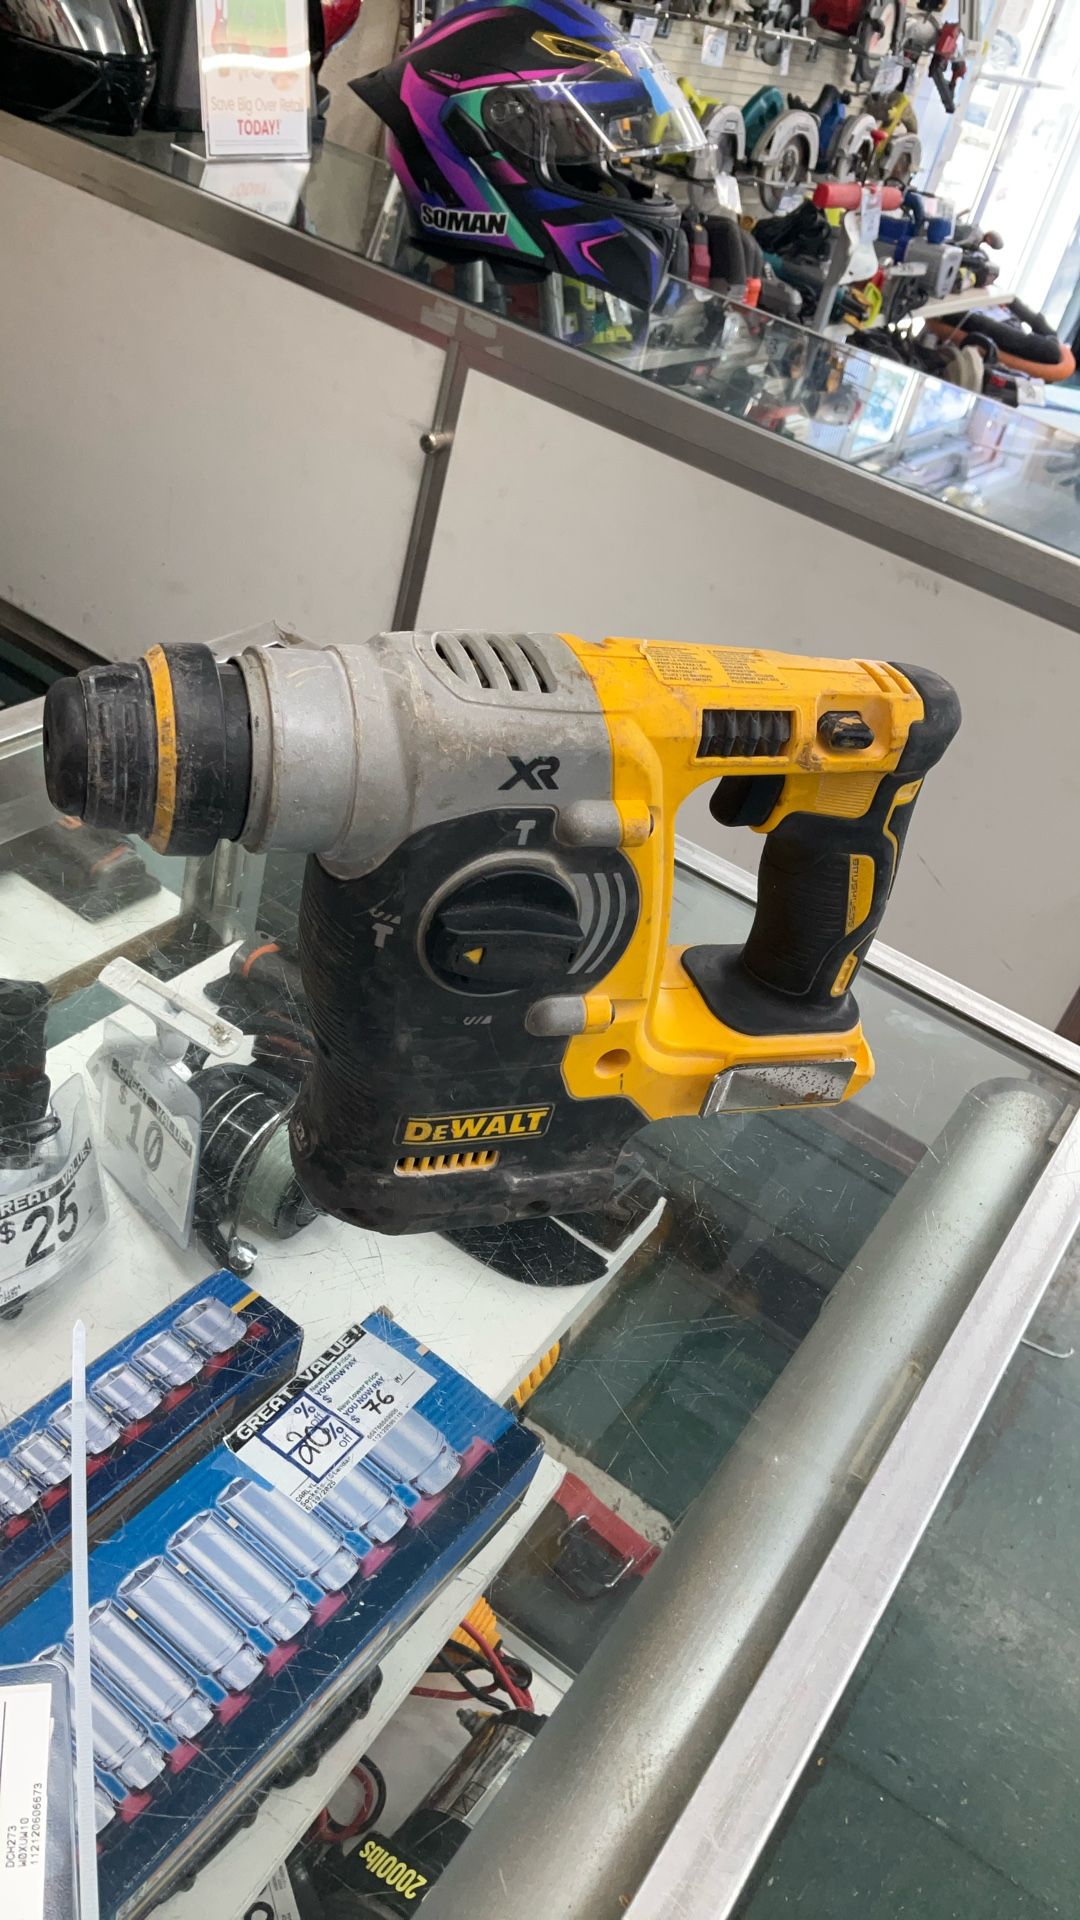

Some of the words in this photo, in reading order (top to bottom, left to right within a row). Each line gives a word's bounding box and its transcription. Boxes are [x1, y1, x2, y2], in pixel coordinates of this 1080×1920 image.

[211, 96, 235, 111] Save
[237, 97, 253, 116] Big
[256, 98, 277, 111] Over
[237, 119, 281, 135] TODAY!
[421, 204, 508, 236] SOMAN
[498, 756, 560, 790] XR
[126, 1101, 163, 1172] 10
[0, 1220, 16, 1245] $
[22, 1180, 78, 1267] 25
[236, 1387, 296, 1441] GREAT
[296, 1325, 362, 1381] VALUE!
[309, 1379, 324, 1392] New
[315, 1385, 330, 1397] YOU
[330, 1370, 346, 1387] NOW
[344, 1357, 357, 1371] PAY
[337, 1400, 351, 1412] New
[349, 1383, 366, 1401] Lower
[365, 1371, 379, 1386] Price
[322, 1394, 333, 1404] $
[343, 1403, 358, 1417] YOU
[357, 1387, 375, 1405] NOW
[373, 1376, 385, 1390] PAY
[361, 1389, 395, 1415] 76
[350, 1414, 361, 1424] $
[339, 1433, 353, 1448] Off
[305, 1481, 336, 1511] 6/19/2025
[30, 1783, 43, 1864] 112120606673
[5, 1825, 17, 1868] DCH273
[359, 1840, 428, 1899] 2000lbs
